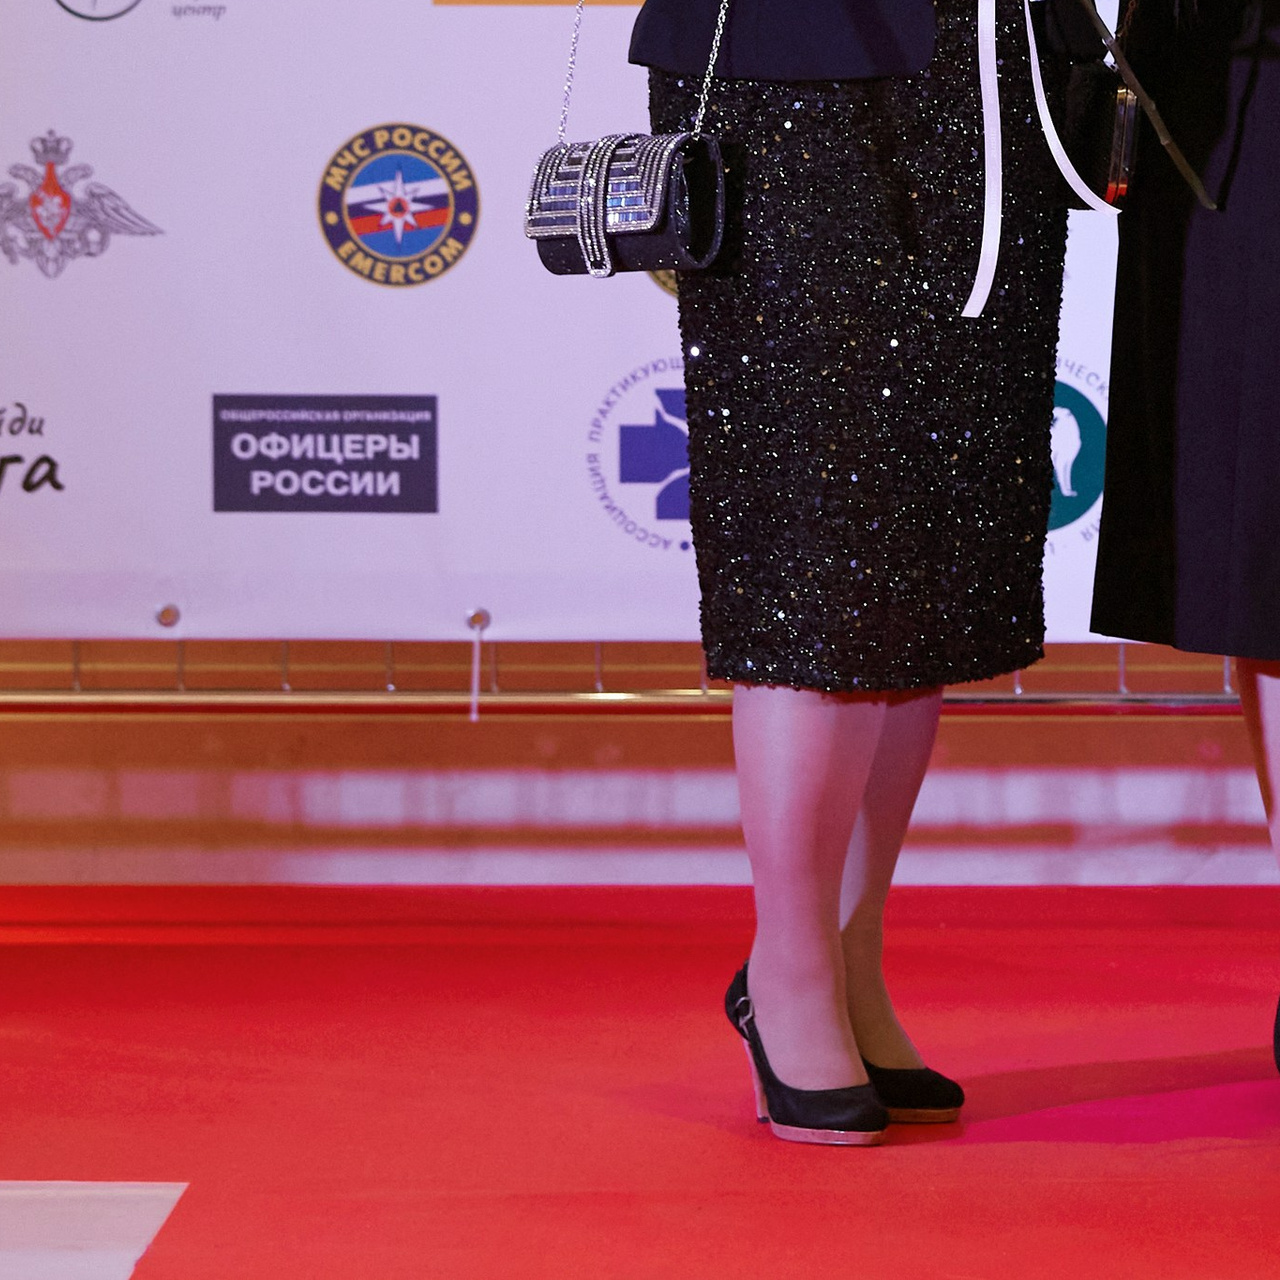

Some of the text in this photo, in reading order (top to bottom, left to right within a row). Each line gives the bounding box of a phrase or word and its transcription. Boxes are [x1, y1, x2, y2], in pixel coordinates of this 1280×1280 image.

[171, 5, 227, 20] центр
[325, 128, 472, 192] МЧС РОССИИ
[338, 238, 464, 283] EMERCOM
[231, 432, 420, 464] ОФИЦЕРЫ
[251, 470, 401, 496] РОССИИ
[587, 453, 672, 550] АССОЦИАЦИЯ
